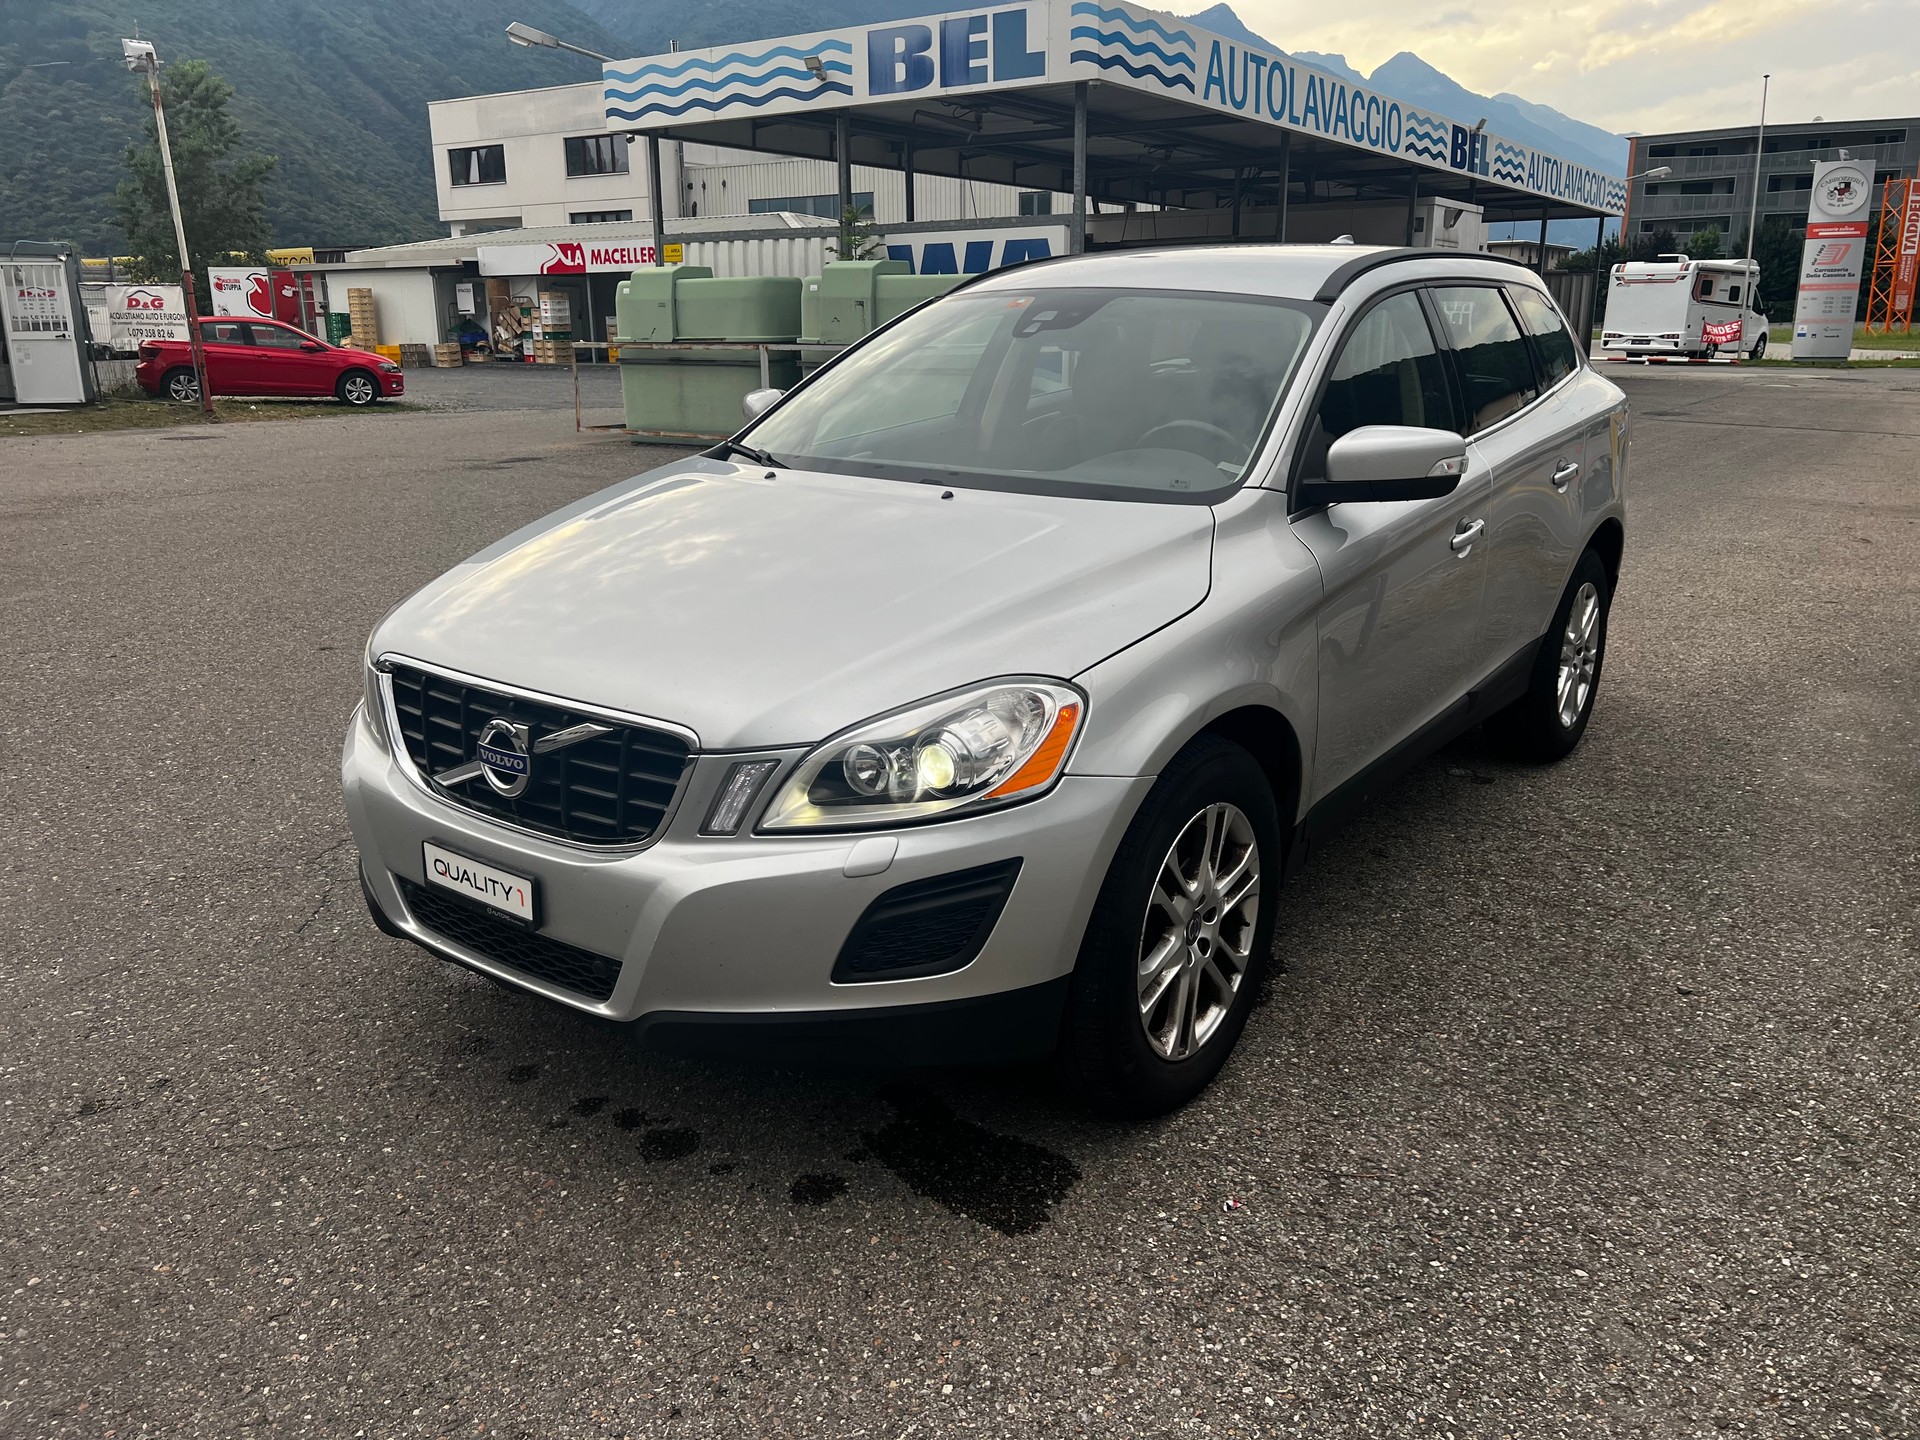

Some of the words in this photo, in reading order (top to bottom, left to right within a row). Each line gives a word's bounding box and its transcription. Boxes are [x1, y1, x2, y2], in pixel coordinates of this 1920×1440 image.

[867, 9, 1046, 96] BEL
[1203, 39, 1402, 153] AUTOLAVAGGIO
[1450, 123, 1490, 177] BEL
[1526, 151, 1607, 208] AUTOLAVAGGIO
[110, 312, 144, 320] ACQUISTIAMO
[146, 312, 159, 320] AUTO
[127, 297, 164, 309] D&G
[131, 328, 144, 338] 079
[145, 328, 156, 338] 358
[156, 328, 166, 338] 82
[166, 329, 175, 339] 66
[480, 751, 524, 770] VOLVO
